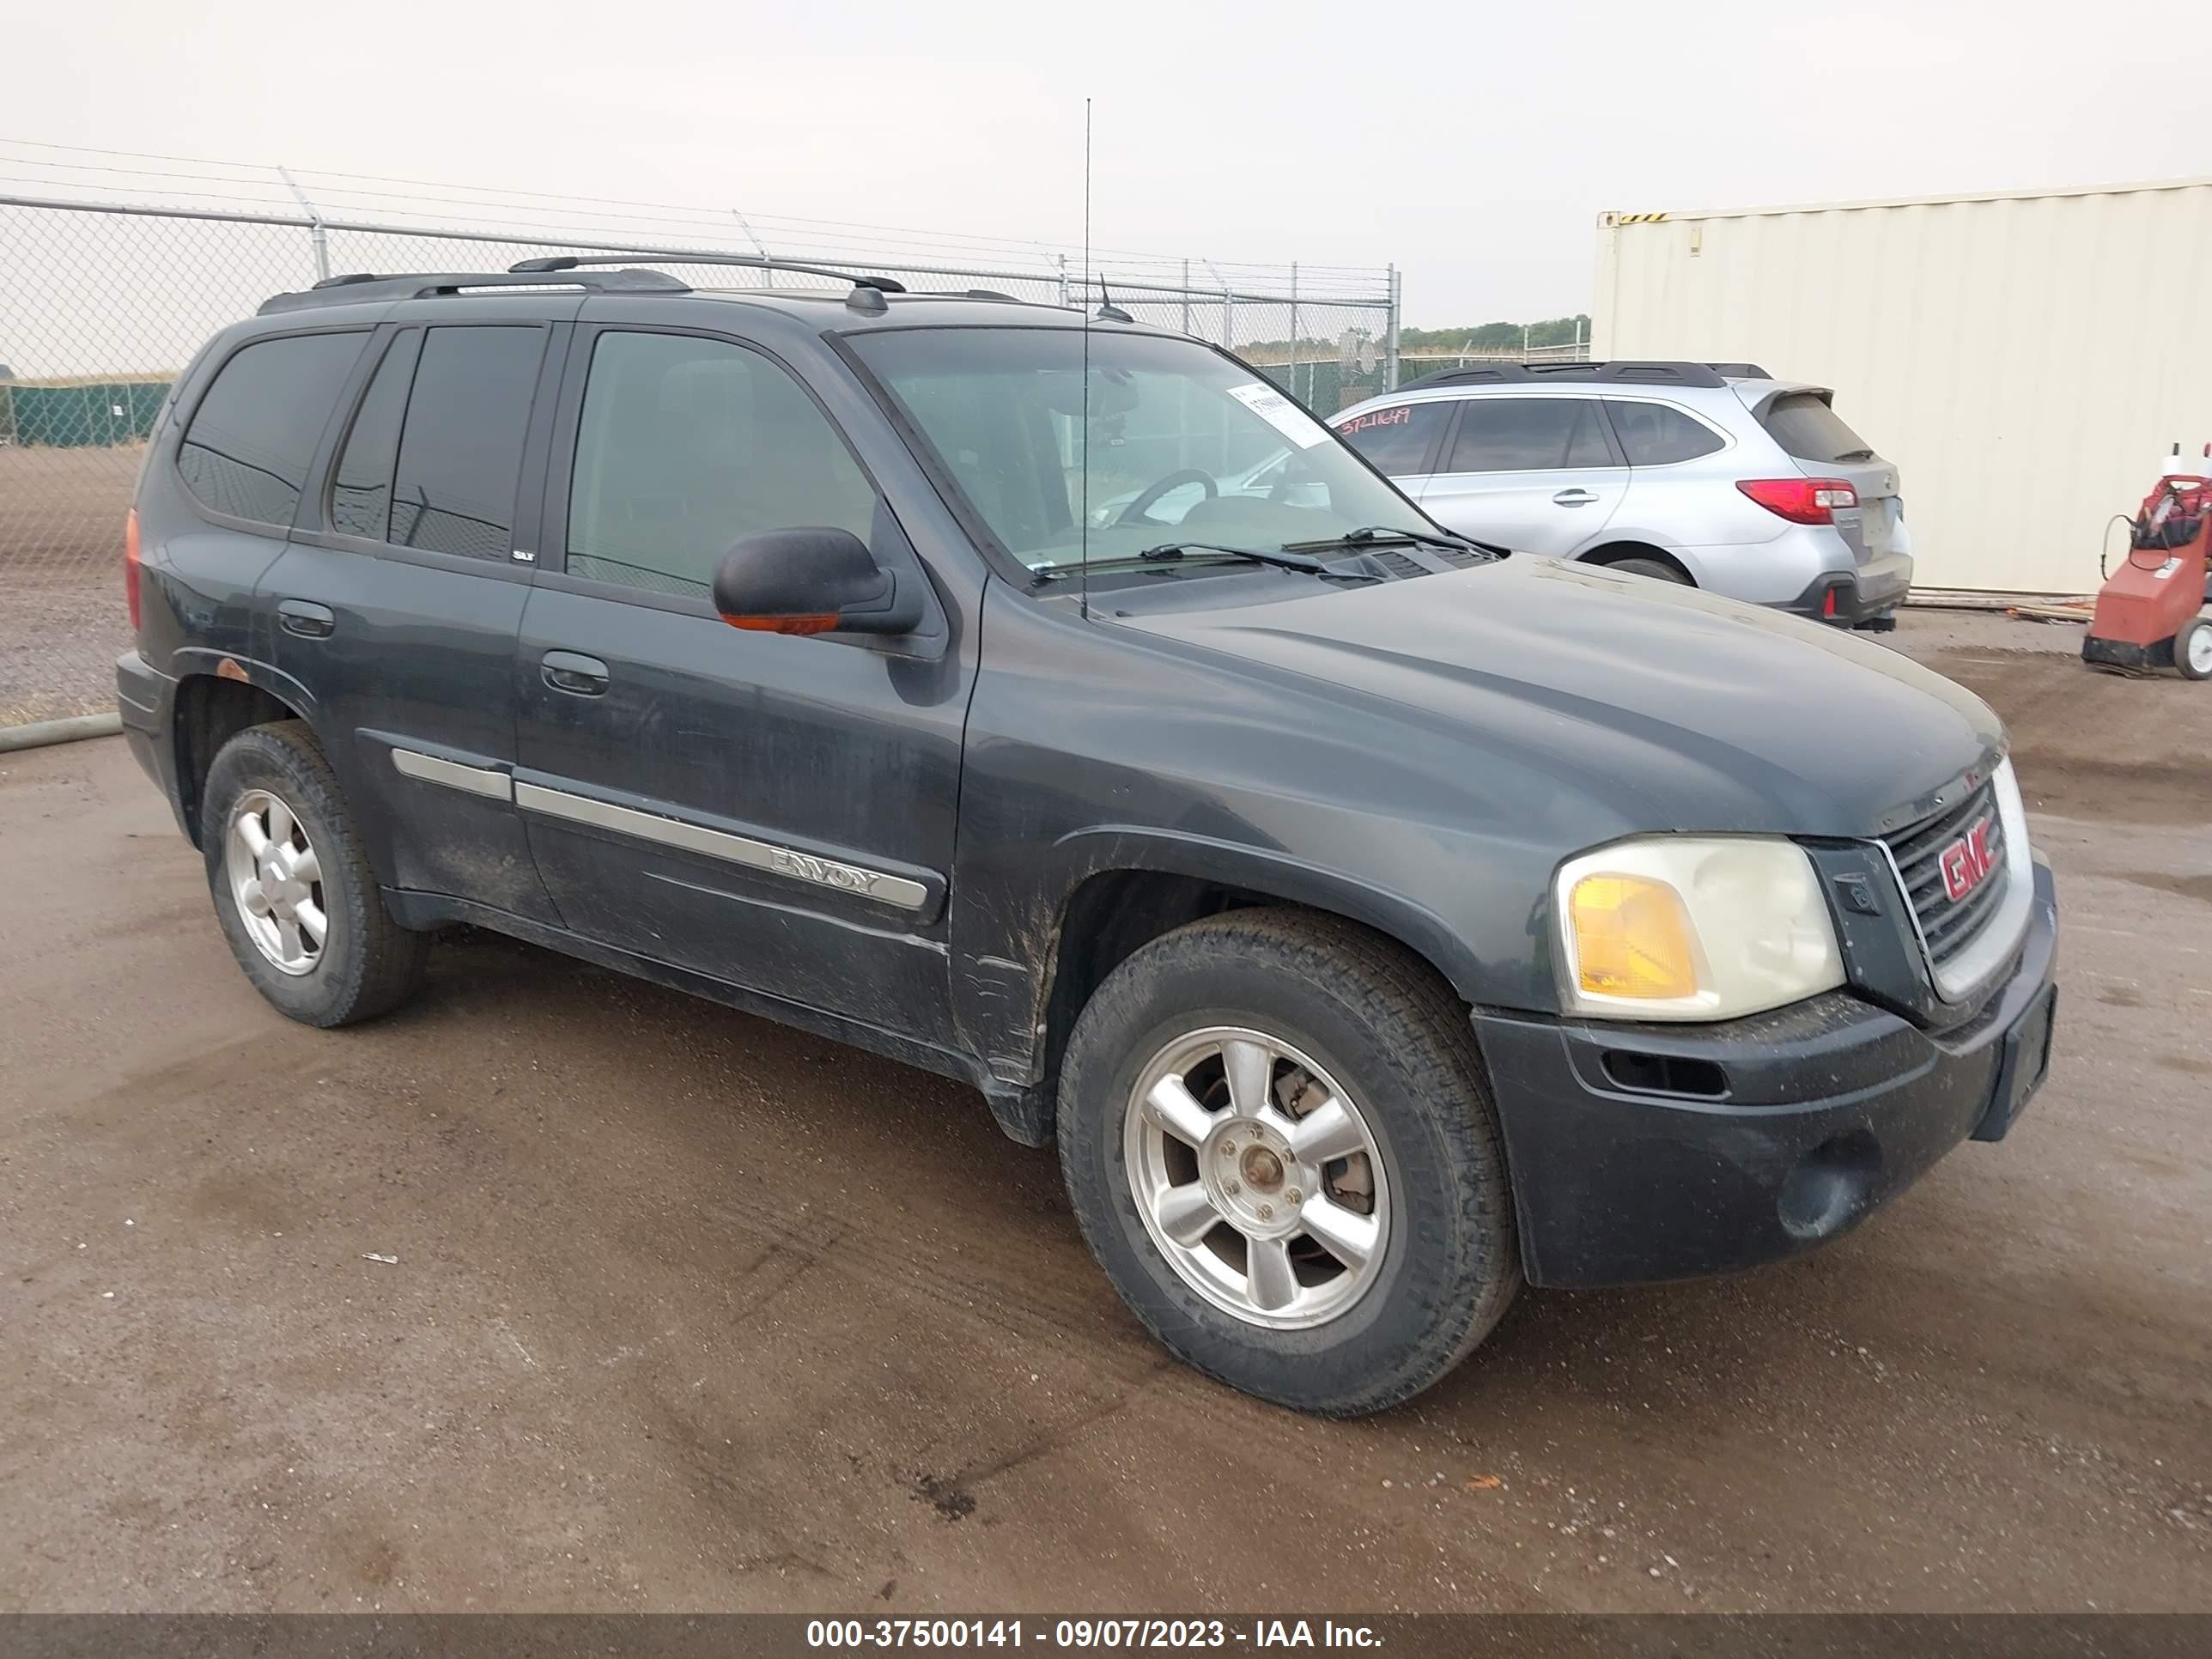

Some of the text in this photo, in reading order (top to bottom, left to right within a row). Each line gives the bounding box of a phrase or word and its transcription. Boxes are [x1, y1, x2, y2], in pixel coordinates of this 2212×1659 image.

[513, 550, 535, 562] SLT
[769, 848, 880, 893] ENVOY
[1939, 817, 2000, 902] GMC
